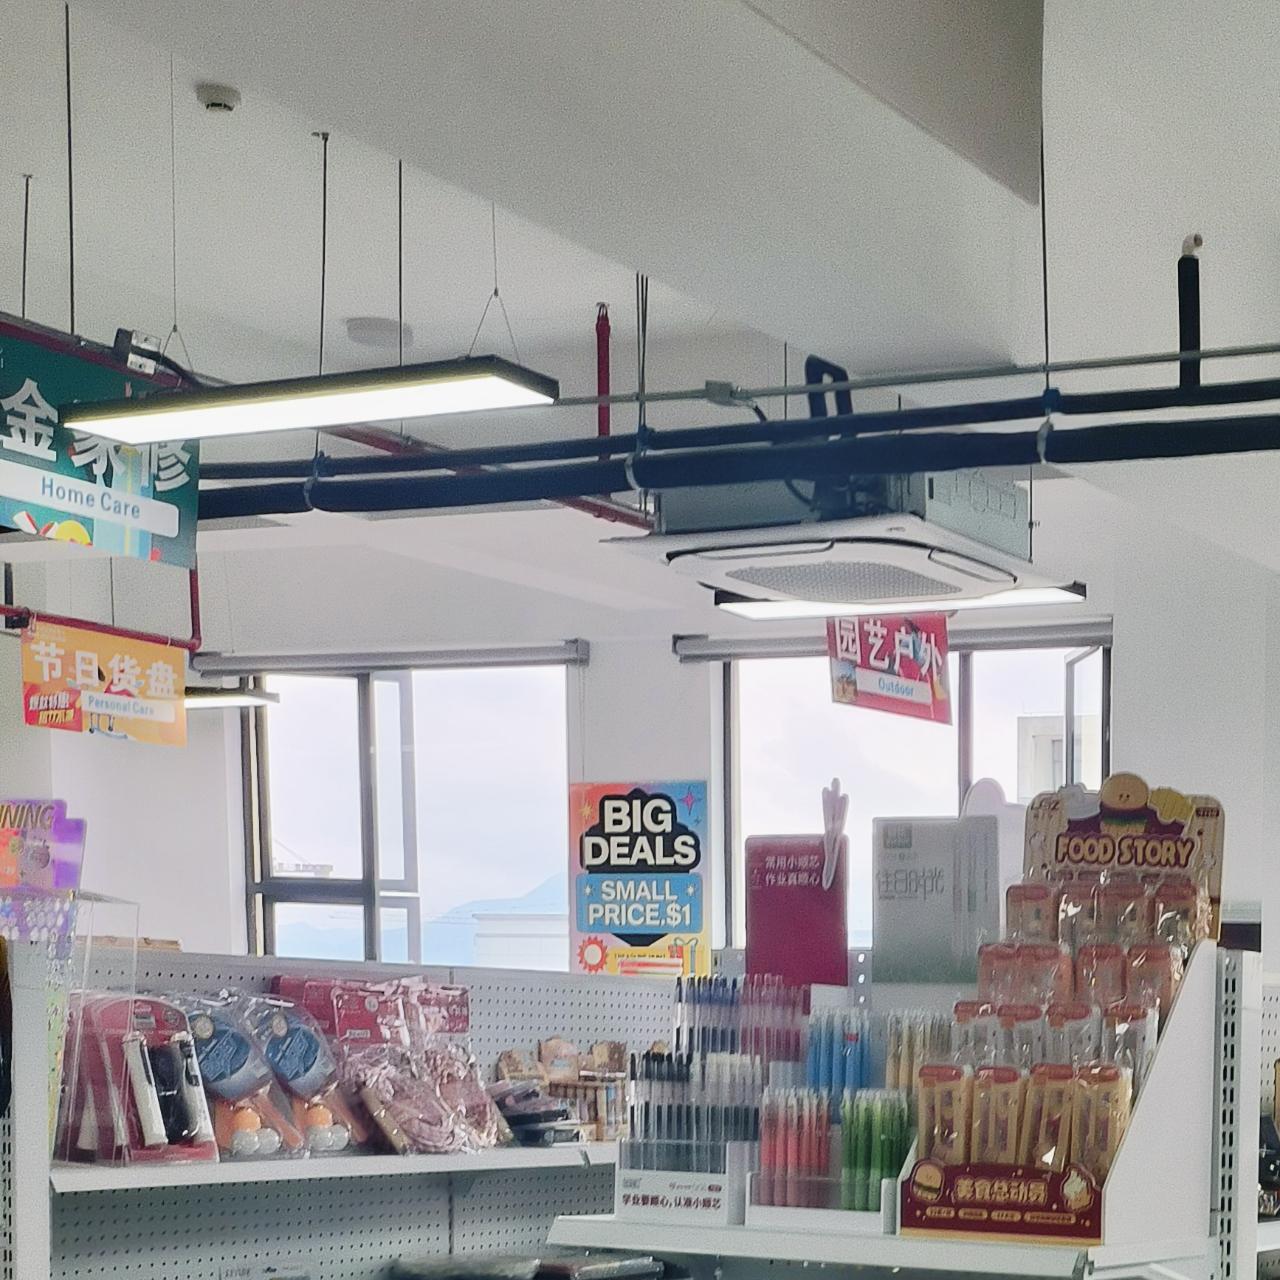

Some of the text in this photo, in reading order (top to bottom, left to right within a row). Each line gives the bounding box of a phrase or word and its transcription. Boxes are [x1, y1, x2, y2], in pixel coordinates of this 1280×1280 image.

[41, 476, 141, 518] Home Care
[834, 616, 943, 684] 园艺户外
[878, 677, 914, 697] Outdoor
[88, 694, 131, 714] Personal
[132, 699, 154, 716] Care
[603, 798, 672, 834] BIG
[584, 834, 697, 867] DEALS
[1055, 833, 1195, 868] FOOD STORY
[601, 879, 678, 901] SMALL
